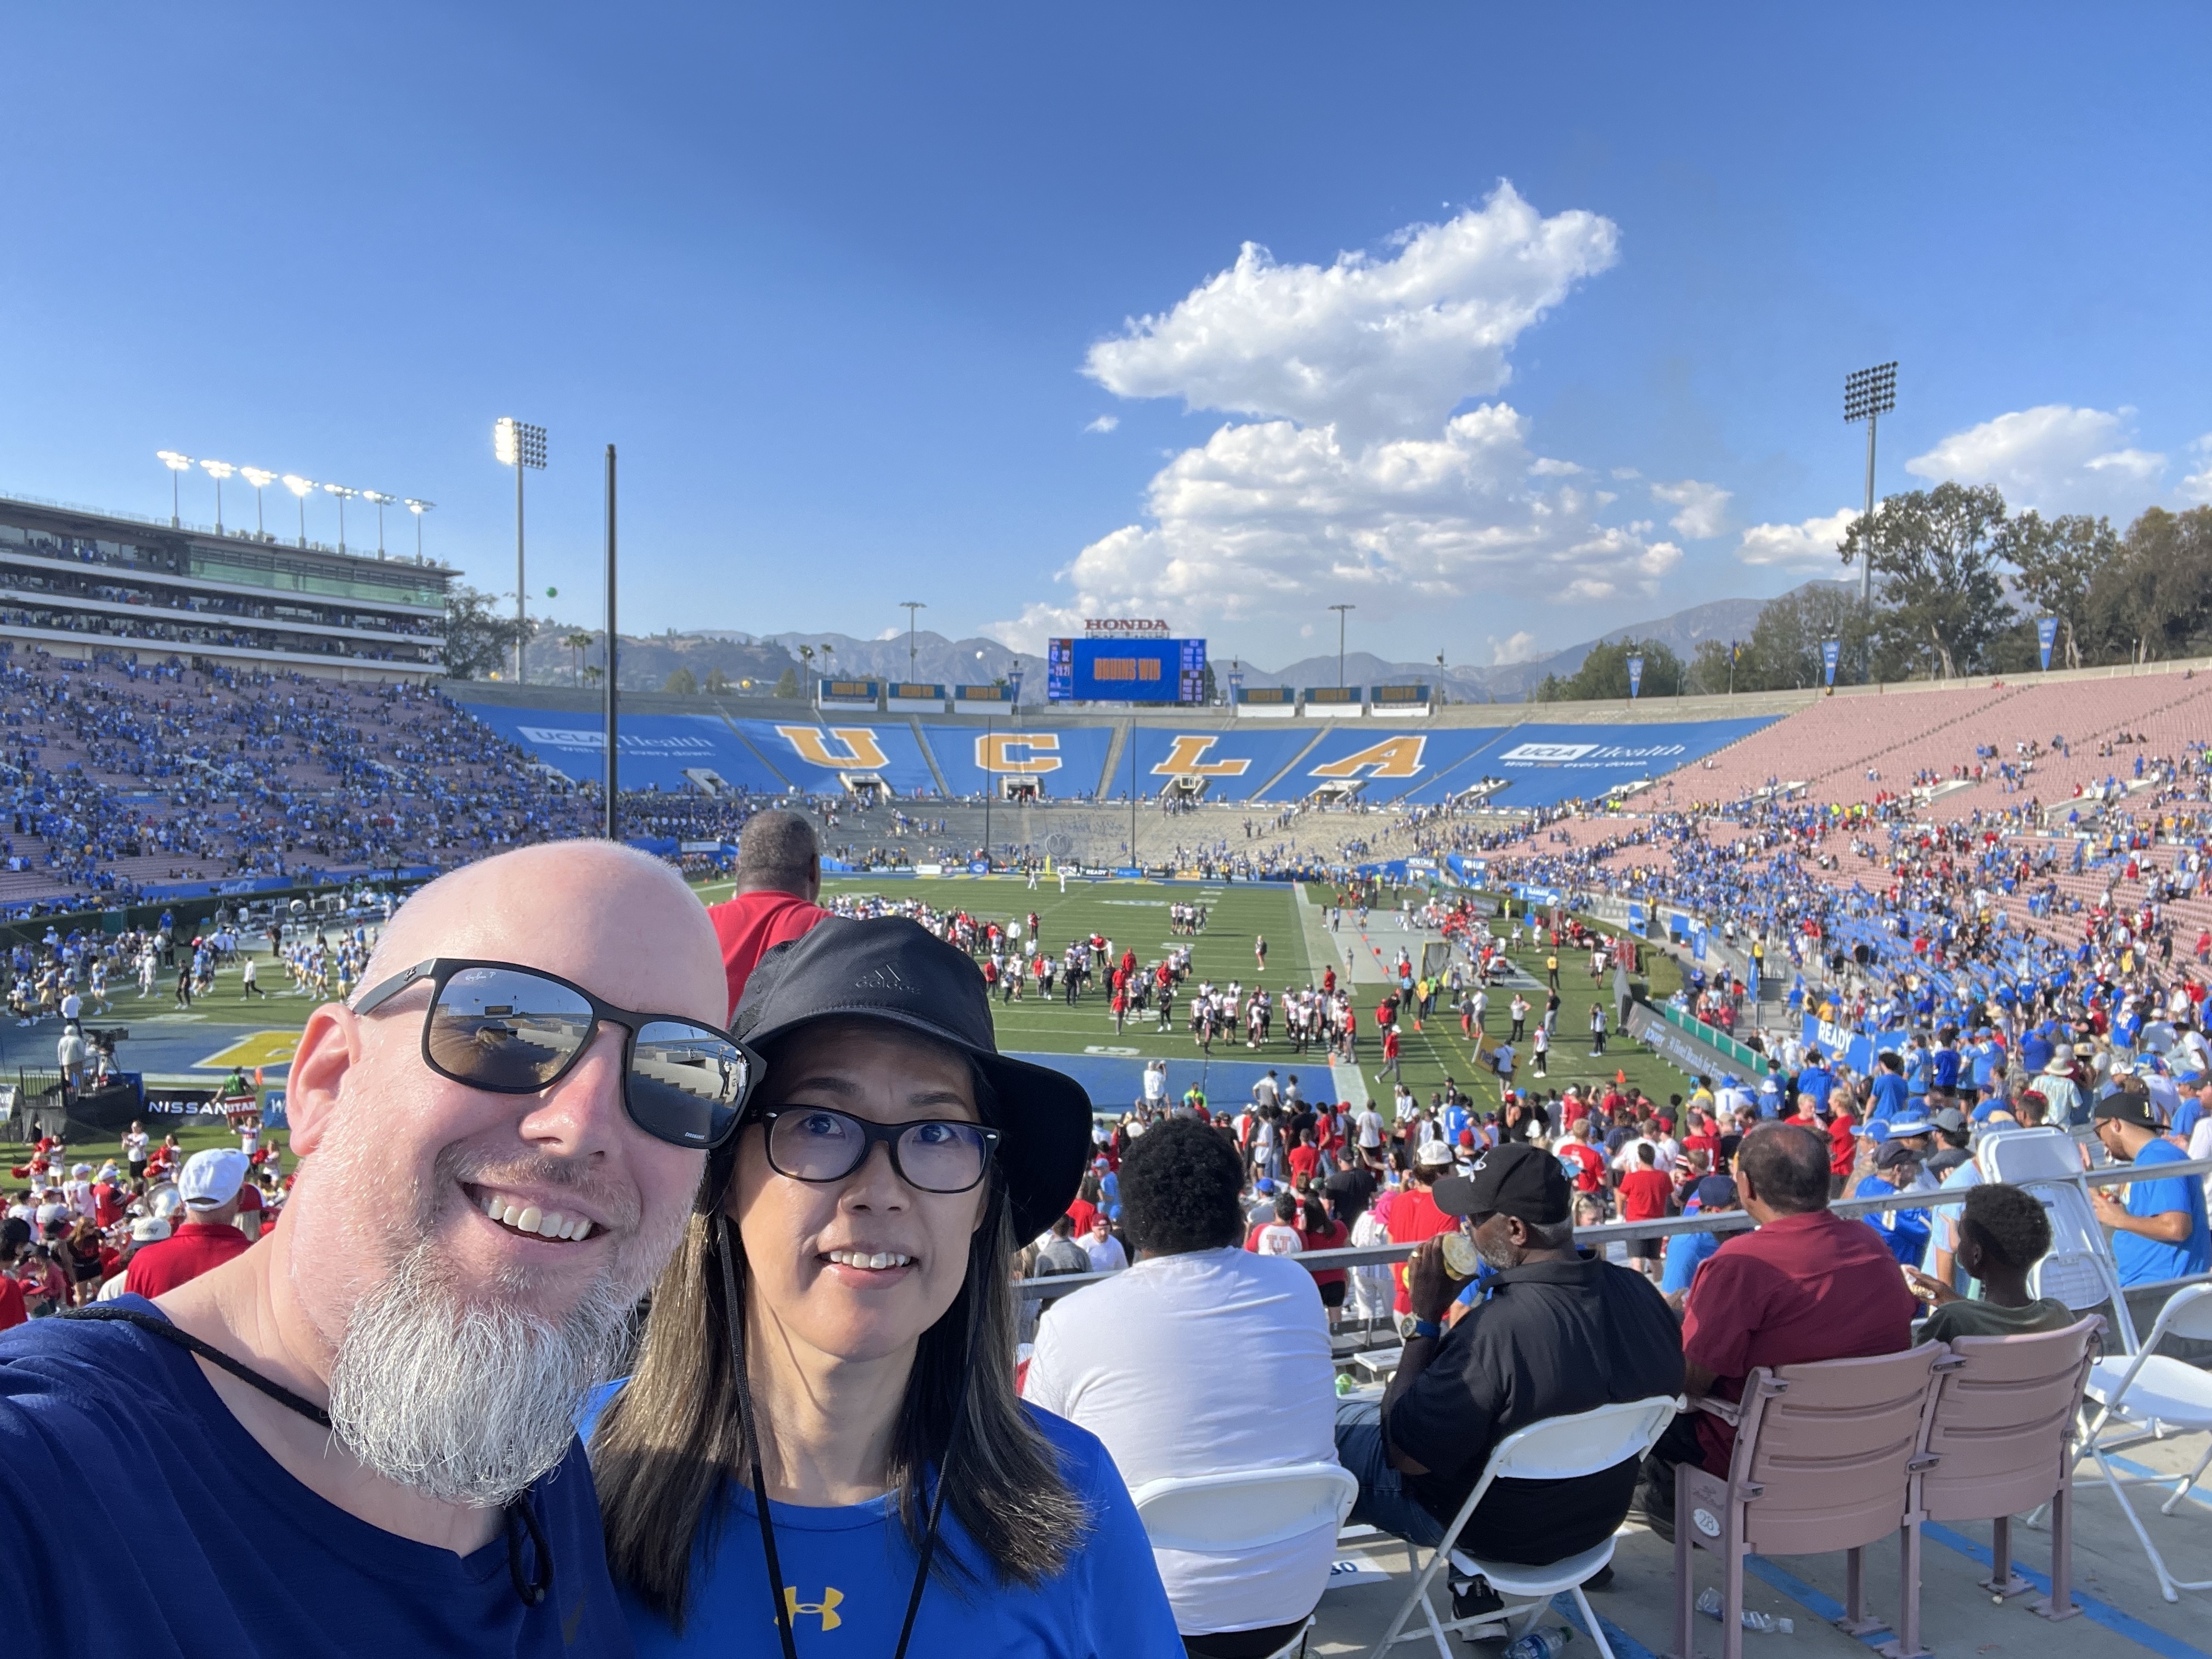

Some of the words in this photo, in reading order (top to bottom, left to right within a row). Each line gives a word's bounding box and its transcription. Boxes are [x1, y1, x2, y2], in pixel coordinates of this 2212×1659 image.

[1085, 619, 1171, 630] HONDA
[534, 731, 603, 743] UCLA
[618, 735, 715, 747] Health
[1518, 747, 1578, 757] UCLA
[1589, 744, 1685, 758] Health
[1818, 1020, 1853, 1054] READY
[148, 1101, 227, 1115] NISSAN
[228, 1102, 257, 1114] UTAH
[1266, 1234, 1291, 1254] U
[1699, 1511, 1714, 1531] 28
